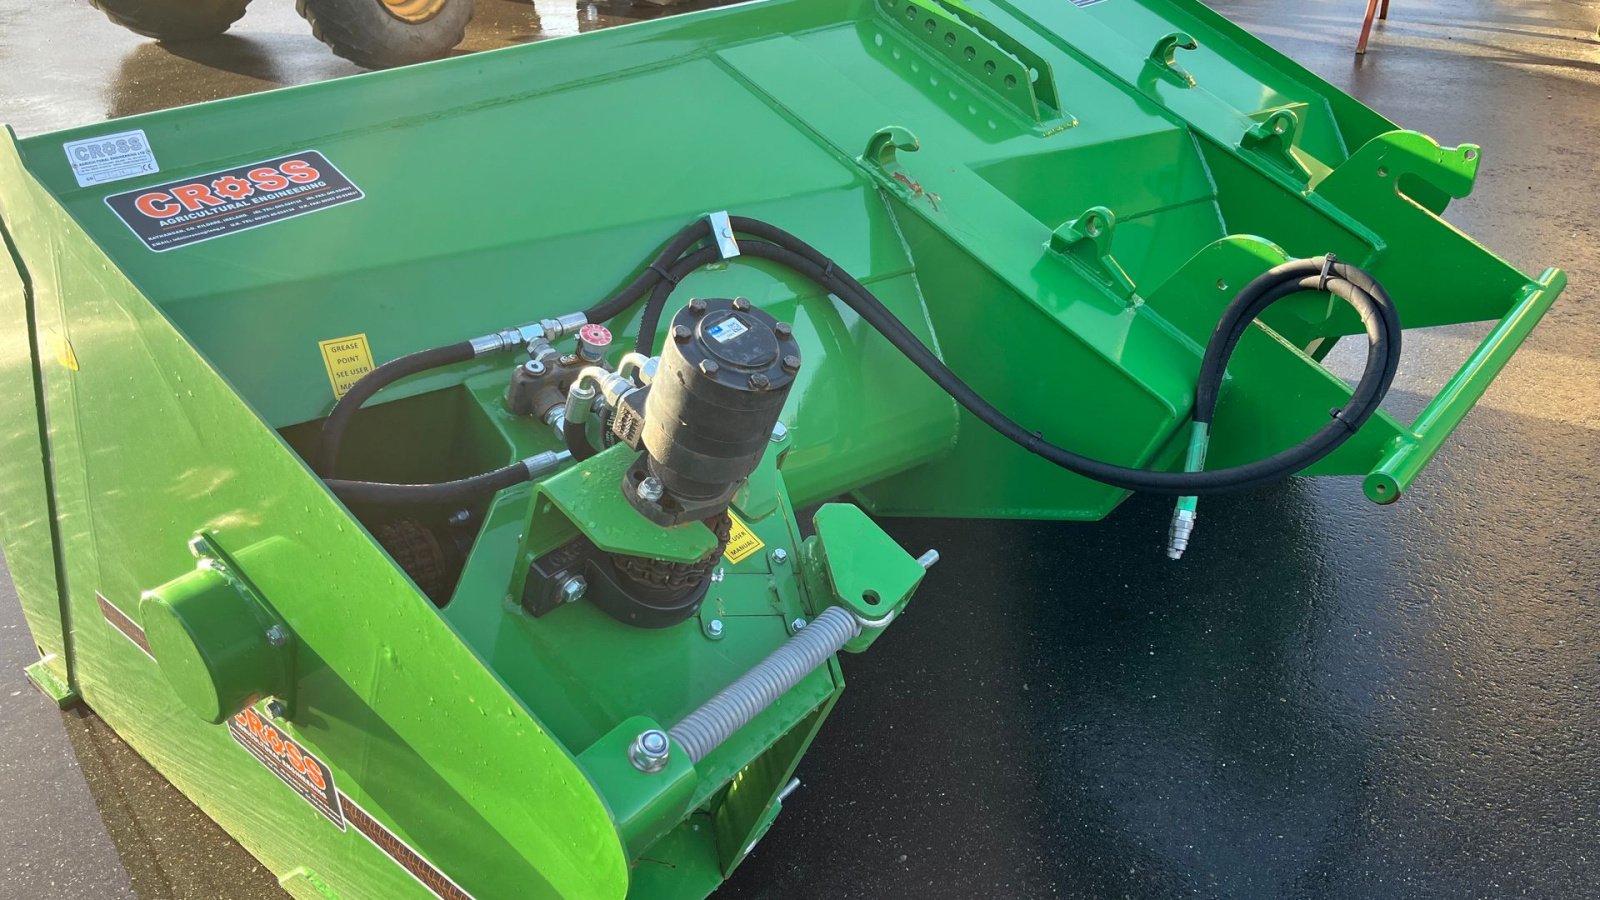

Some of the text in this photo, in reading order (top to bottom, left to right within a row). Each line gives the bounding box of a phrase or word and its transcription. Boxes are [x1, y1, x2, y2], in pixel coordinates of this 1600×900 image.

[75, 137, 142, 161] CROSS
[135, 160, 320, 218] CROSS
[159, 181, 327, 226] AGRICULTURAL ENGINEERING
[331, 343, 359, 353] GREASE
[337, 355, 359, 364] POINT
[336, 367, 369, 378] SEE USER
[732, 531, 747, 541] USER
[730, 540, 754, 555] MANUAL
